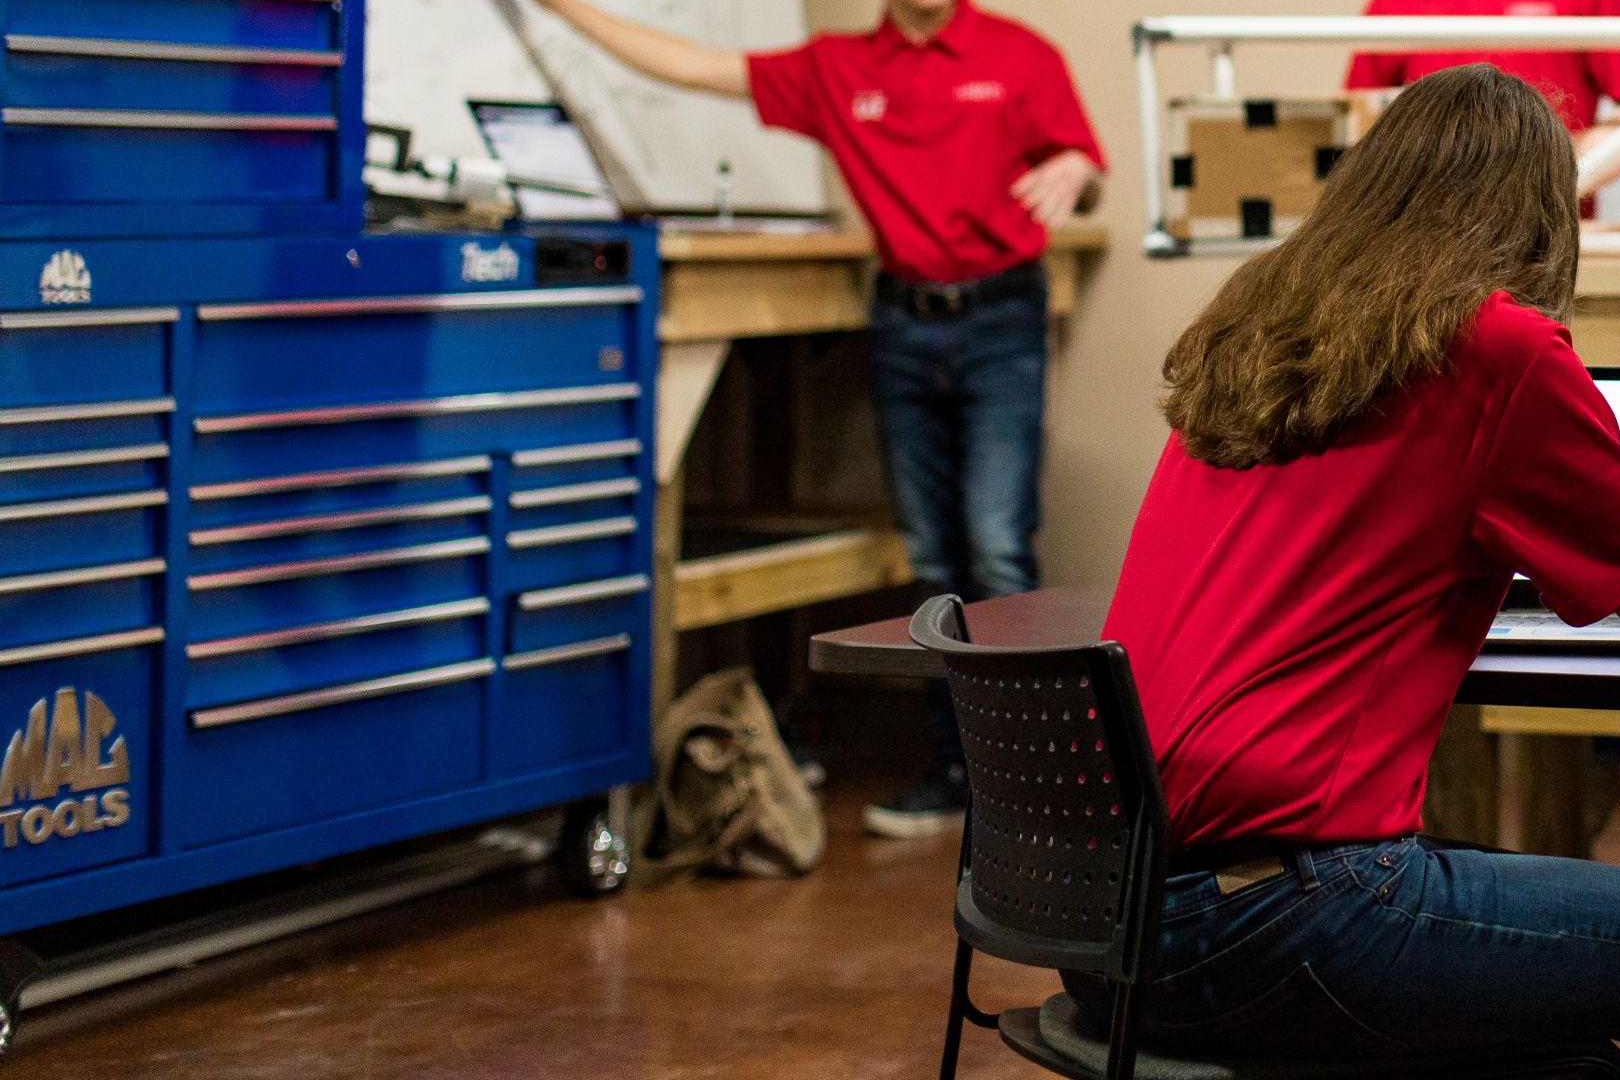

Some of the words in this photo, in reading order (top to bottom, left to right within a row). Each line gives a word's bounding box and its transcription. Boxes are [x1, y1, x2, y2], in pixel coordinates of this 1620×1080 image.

[40, 249, 91, 289] MAC
[461, 242, 518, 281] Tech
[0, 686, 129, 807] MAC
[0, 788, 130, 847] TOOLS
